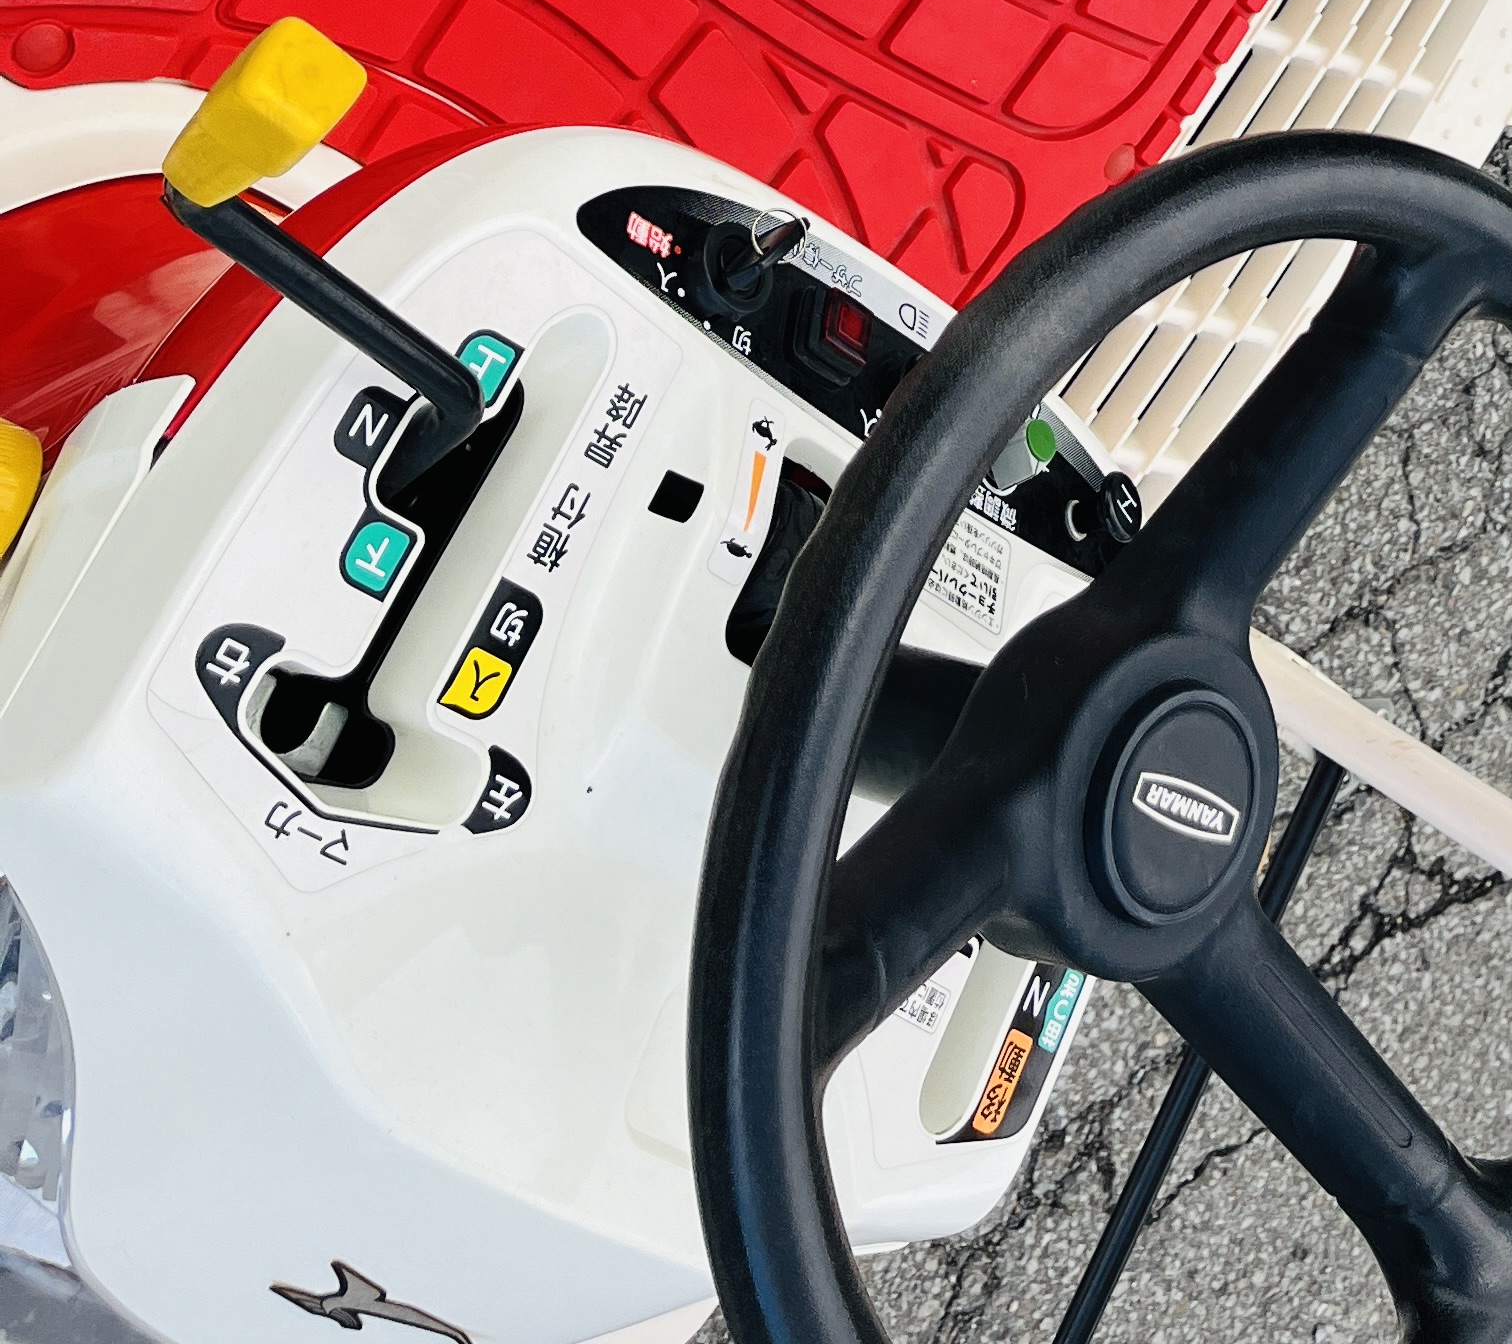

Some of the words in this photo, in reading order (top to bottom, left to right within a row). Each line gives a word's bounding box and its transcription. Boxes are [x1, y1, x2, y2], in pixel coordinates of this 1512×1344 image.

[626, 211, 673, 258] 始動
[657, 262, 677, 293] 入
[732, 325, 752, 356] 切
[347, 403, 389, 447] N
[527, 481, 594, 574] 植付
[583, 381, 651, 469] 昇降
[353, 536, 390, 578] 下
[489, 602, 530, 648] 切
[205, 637, 253, 686] 右
[468, 658, 503, 702] 入
[480, 773, 524, 822] 左
[1145, 783, 1224, 831] YANMAR
[264, 800, 351, 866] マーカ
[1022, 974, 1050, 1017] N
[980, 1043, 1026, 1124] 移動
